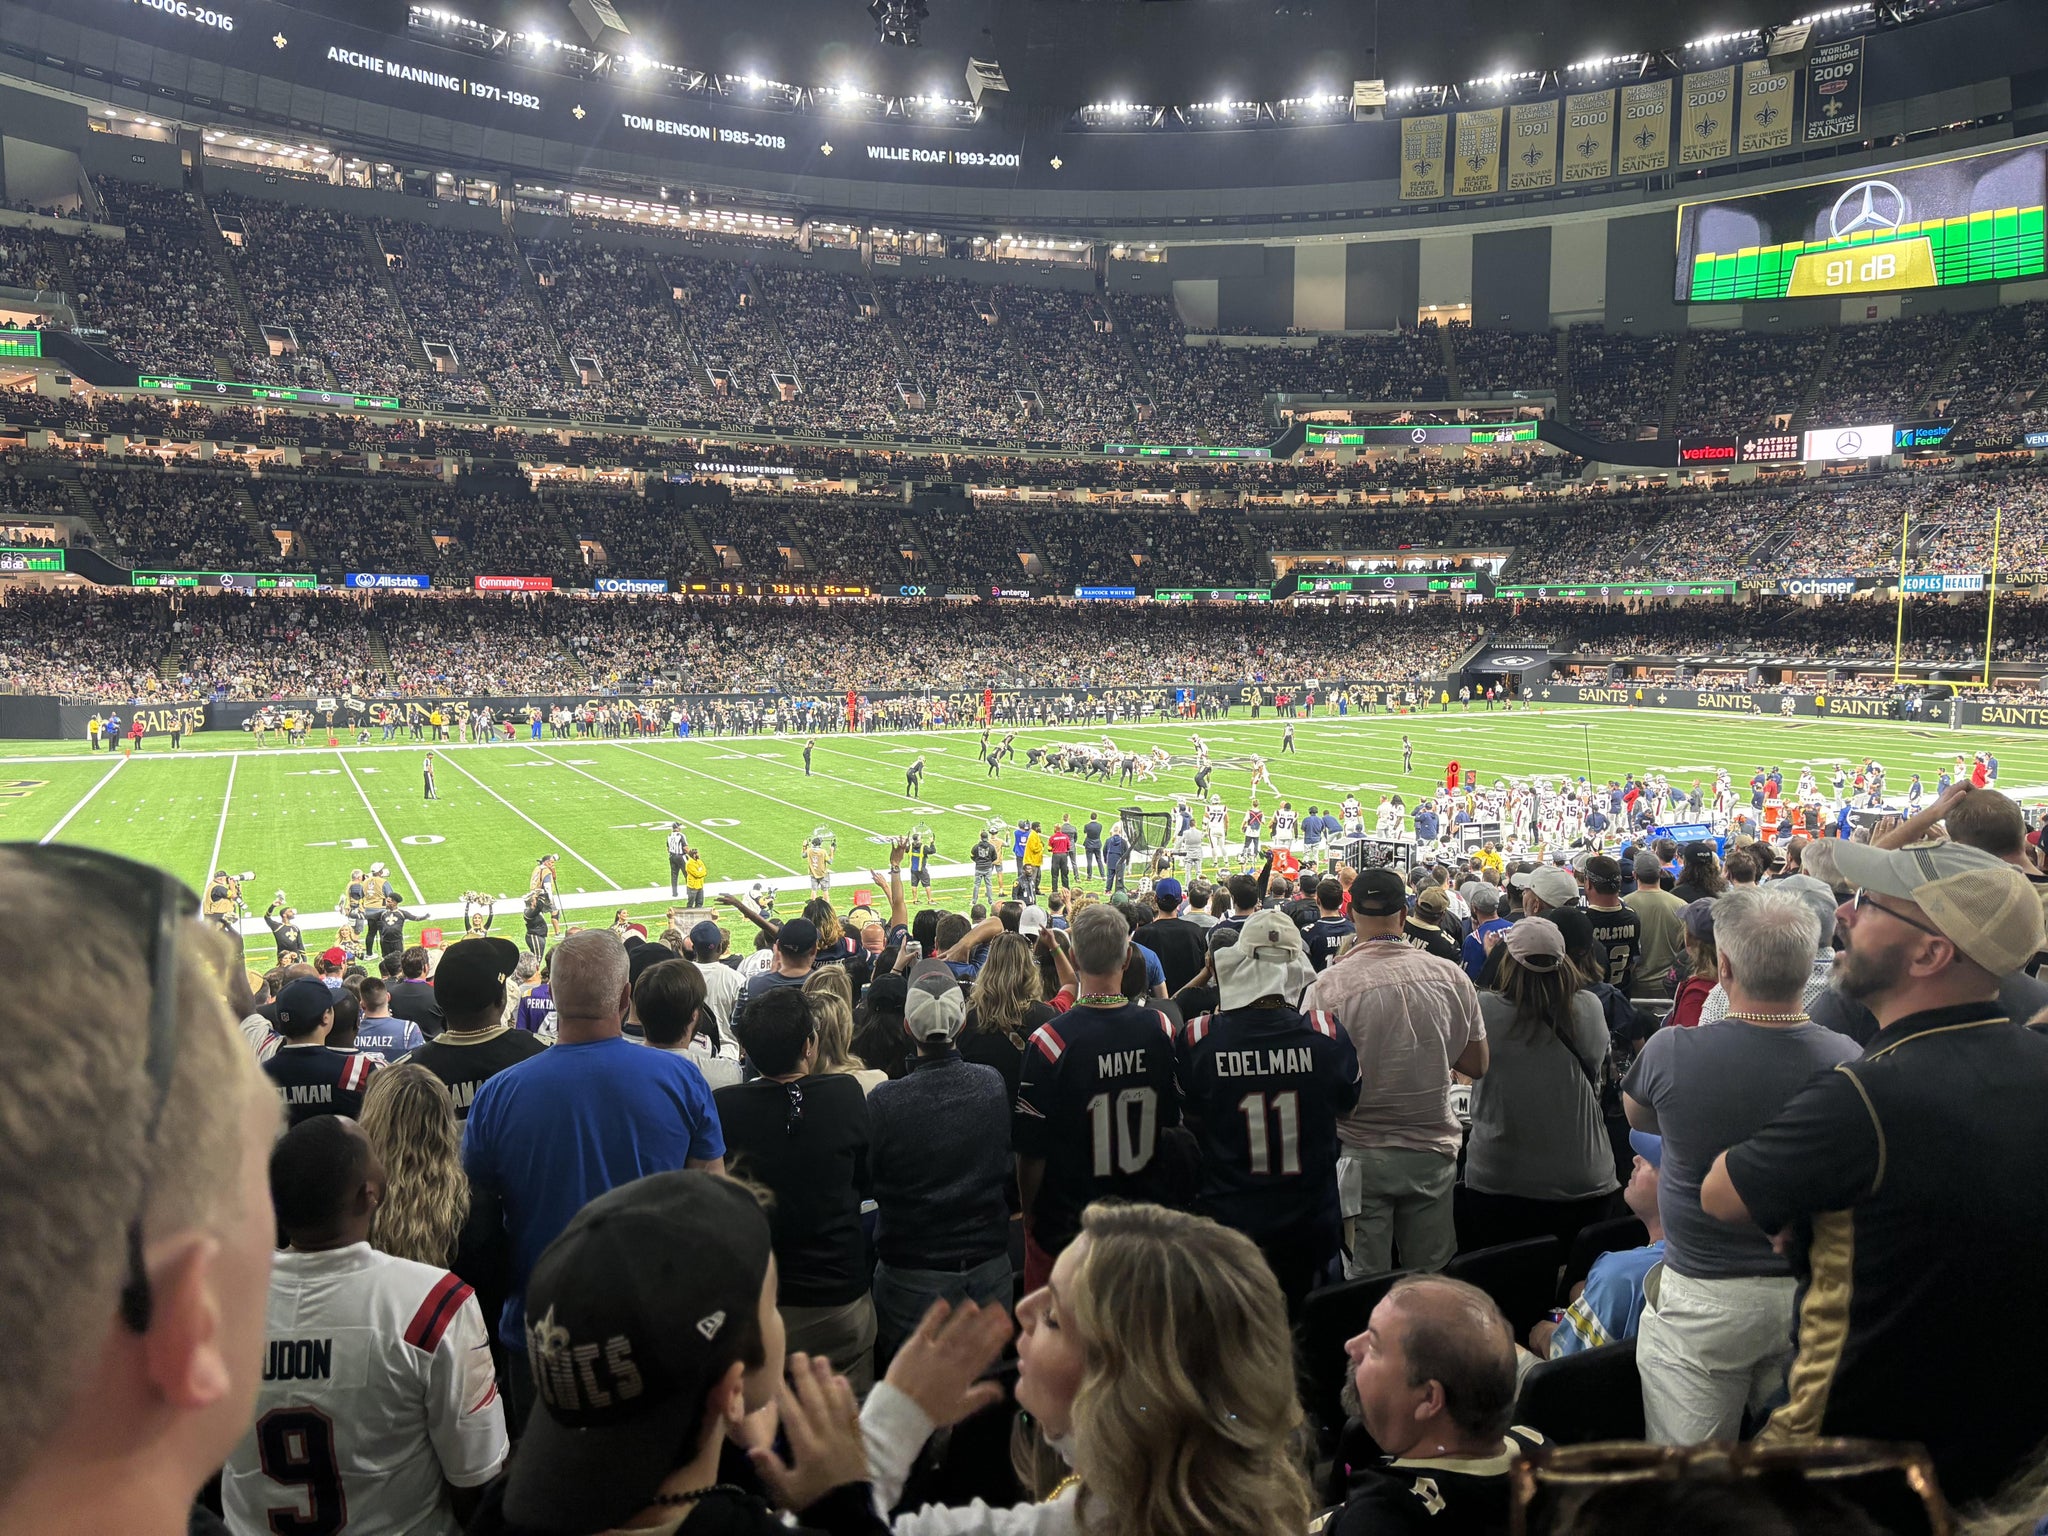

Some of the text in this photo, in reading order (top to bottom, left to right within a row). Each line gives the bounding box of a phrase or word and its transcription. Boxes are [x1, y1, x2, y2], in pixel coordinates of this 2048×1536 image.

[1811, 49, 1859, 65] CHAMPIONS
[1820, 44, 1850, 55] WORLD
[327, 46, 540, 110] ARCHIE MANNING 1971-1982
[1814, 63, 1854, 82] 2009
[1748, 77, 1788, 96] 2009
[1689, 90, 1727, 107] 2009
[1627, 102, 1664, 119] 2006
[1571, 111, 1607, 127] 2000
[622, 113, 786, 149] TOM BENSON 1985-2018
[1518, 121, 1549, 137] 1991
[1808, 121, 1855, 139] SAINTS
[1743, 134, 1788, 151] SAINTS
[132, 155, 145, 164] 636
[867, 145, 1020, 167] WILLIE ROAF 1993-2001
[1683, 145, 1727, 161] SAINTS
[1622, 157, 1665, 172] SAINTS
[1566, 165, 1608, 180] SAINTS
[1511, 175, 1552, 188] SAINTS
[1826, 254, 1896, 287] 91 dB
[405, 399, 1091, 452] SAINTS SAINTS SAINTS SAINTS SAINTS SAINTS SAINTS SAINTS SAINTS SAINTS
[65, 420, 692, 470] SAINTS SAINTS SAINTS SAINTS SAINTS SAINTS SAINTS SAINTS
[1756, 436, 1798, 445] PATRON
[1756, 443, 1797, 452] SAINTS
[1975, 435, 2013, 448] SAINTS
[1682, 445, 1735, 460] verizon
[1742, 451, 1797, 461] PARTNERS
[694, 462, 795, 475] CAESARS SUPERDOME
[794, 468, 824, 477] SAINTS
[859, 471, 889, 479] SAINTS
[924, 474, 953, 482] SAINTS
[986, 477, 1015, 485] SAINTS
[1051, 479, 1078, 487] SAINTS
[1111, 481, 1139, 489] SAINTS
[1232, 482, 1260, 490] SAINTS
[1360, 481, 1389, 489] SAINTS
[1426, 478, 1455, 486] SAINTS
[1490, 476, 1518, 484] SAINTS
[434, 577, 470, 586] SAINTS
[479, 577, 525, 590] Community
[1902, 576, 1981, 590] PEOPLES HEALTH
[2005, 573, 2048, 584] SAINTS
[607, 580, 665, 593] Ochsner
[680, 584, 687, 594] 3
[720, 584, 730, 593] 19
[900, 585, 927, 596] COX
[1001, 588, 1030, 598] entergy
[1789, 579, 1854, 595] Ochsner
[1579, 688, 1628, 702] SAINTS
[1698, 693, 1752, 708] SAINTS
[1831, 699, 1891, 716] SAINTS
[1981, 706, 2048, 725] SAINTS
[1209, 812, 1224, 823] 77
[1344, 806, 1359, 818] 53
[1566, 805, 1577, 816] 15
[1278, 817, 1294, 829] 97
[1593, 924, 1635, 941] COLSTON
[354, 1035, 393, 1047] ONZALEZ
[1098, 1049, 1147, 1079] MAYE
[1215, 1047, 1313, 1077] EDELMAN
[1086, 1086, 1158, 1177] 10
[1238, 1090, 1303, 1176] 11
[256, 1404, 347, 1536] 9
